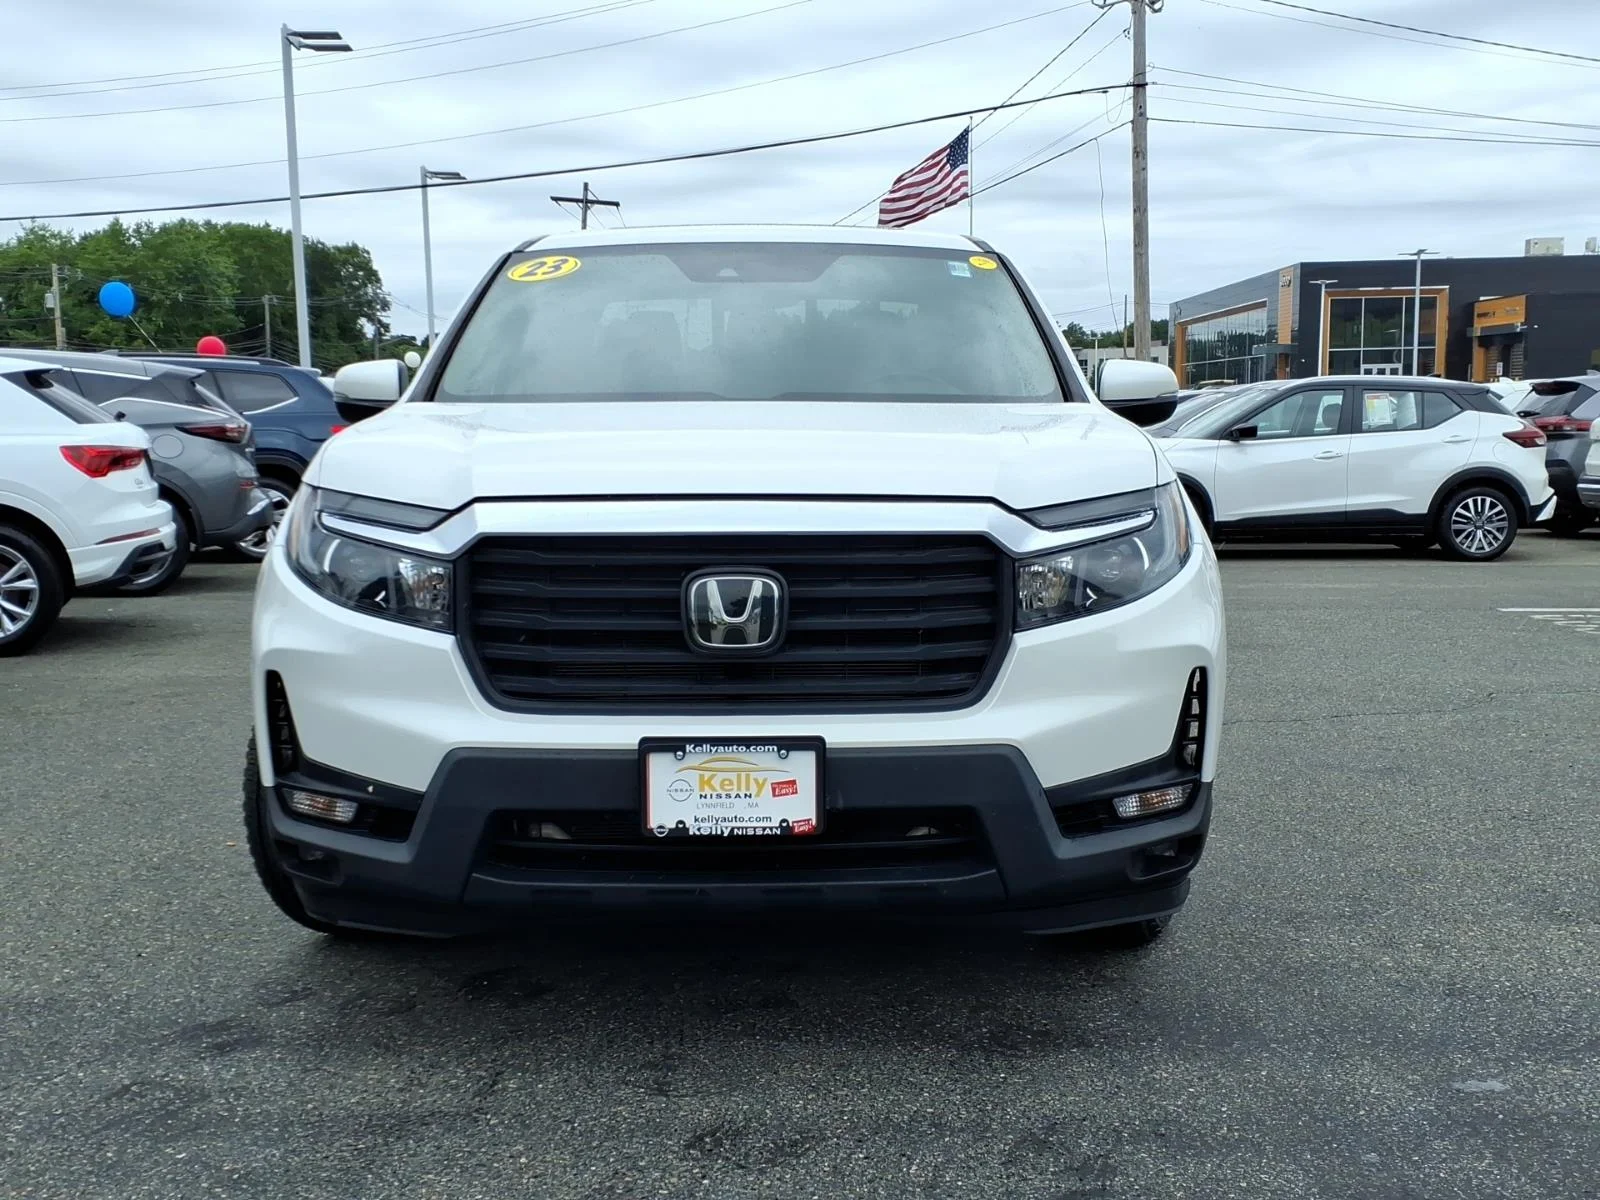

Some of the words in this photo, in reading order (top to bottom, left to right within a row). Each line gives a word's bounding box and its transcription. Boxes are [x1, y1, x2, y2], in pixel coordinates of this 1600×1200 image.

[517, 258, 569, 278] 23
[685, 743, 778, 755] Kellyauto.com
[697, 773, 769, 799] Kelly
[699, 792, 753, 800] NISSAN
[696, 802, 735, 810] LYNNFIELD
[693, 815, 772, 826] kellyauto.com
[688, 823, 733, 837] Kelly
[733, 827, 782, 836] NISSAN
